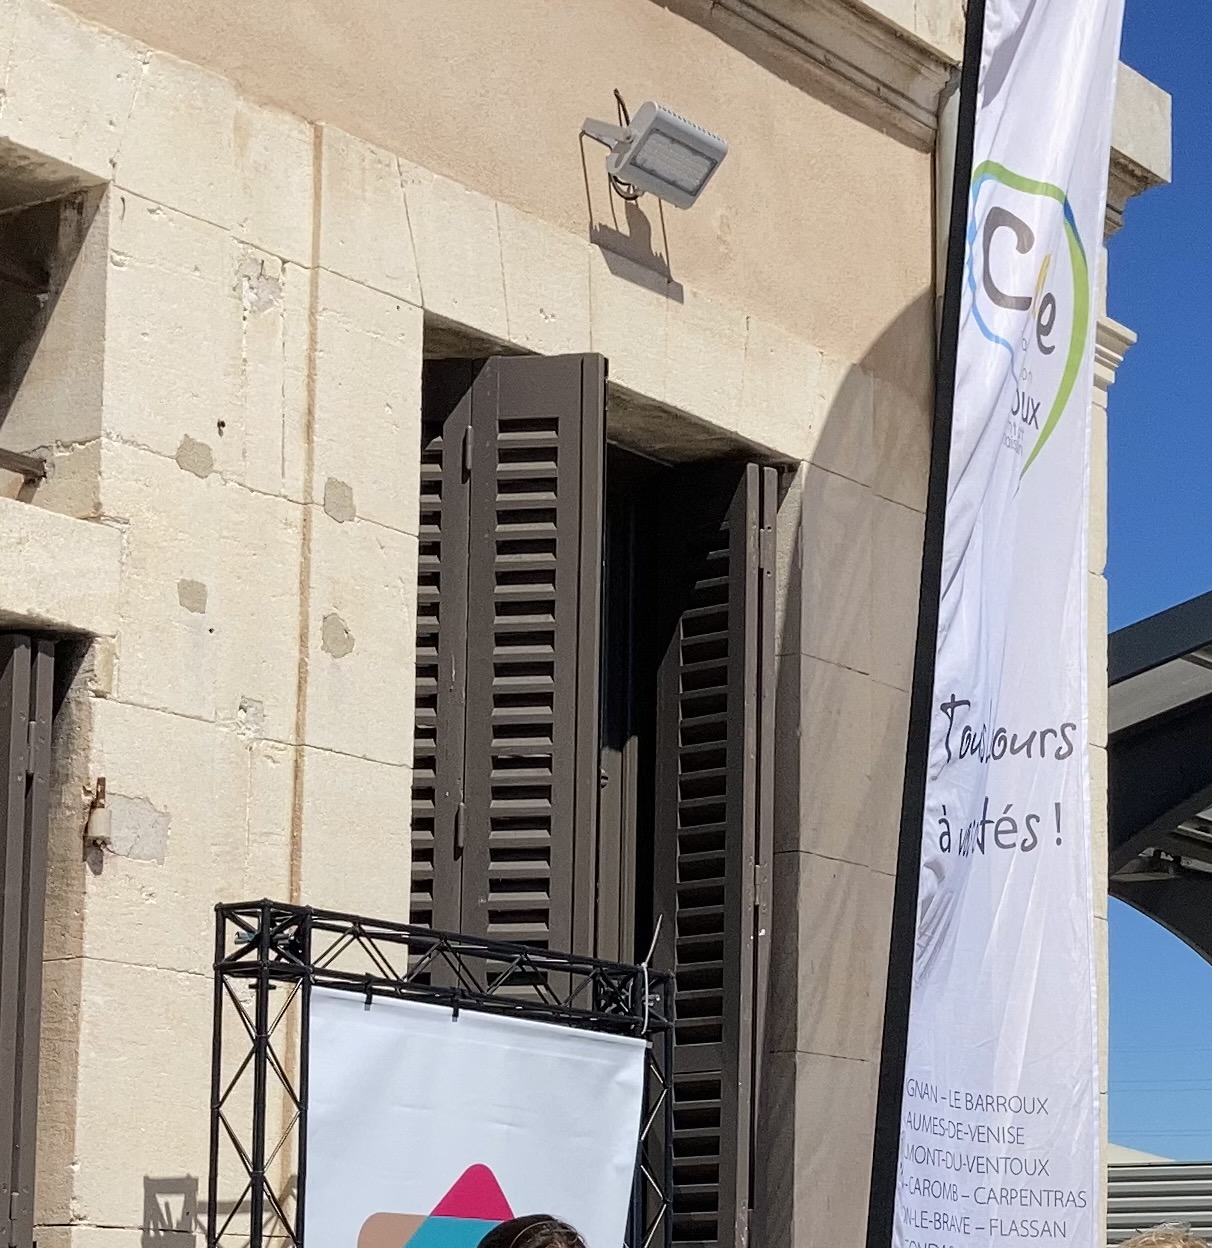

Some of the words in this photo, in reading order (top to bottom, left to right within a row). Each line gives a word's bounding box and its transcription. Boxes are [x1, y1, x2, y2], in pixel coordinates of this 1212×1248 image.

[906, 1078, 938, 1103] GNAN
[949, 1089, 962, 1109] LE
[965, 1092, 1049, 1115] BARROUX
[906, 1111, 1025, 1145] AUMES-DE-VENISE
[904, 1143, 1050, 1177] MONT-DU-VENTOUX
[974, 1186, 1087, 1208] CARPENTRAS
[989, 1218, 1067, 1238] FLASSAN
